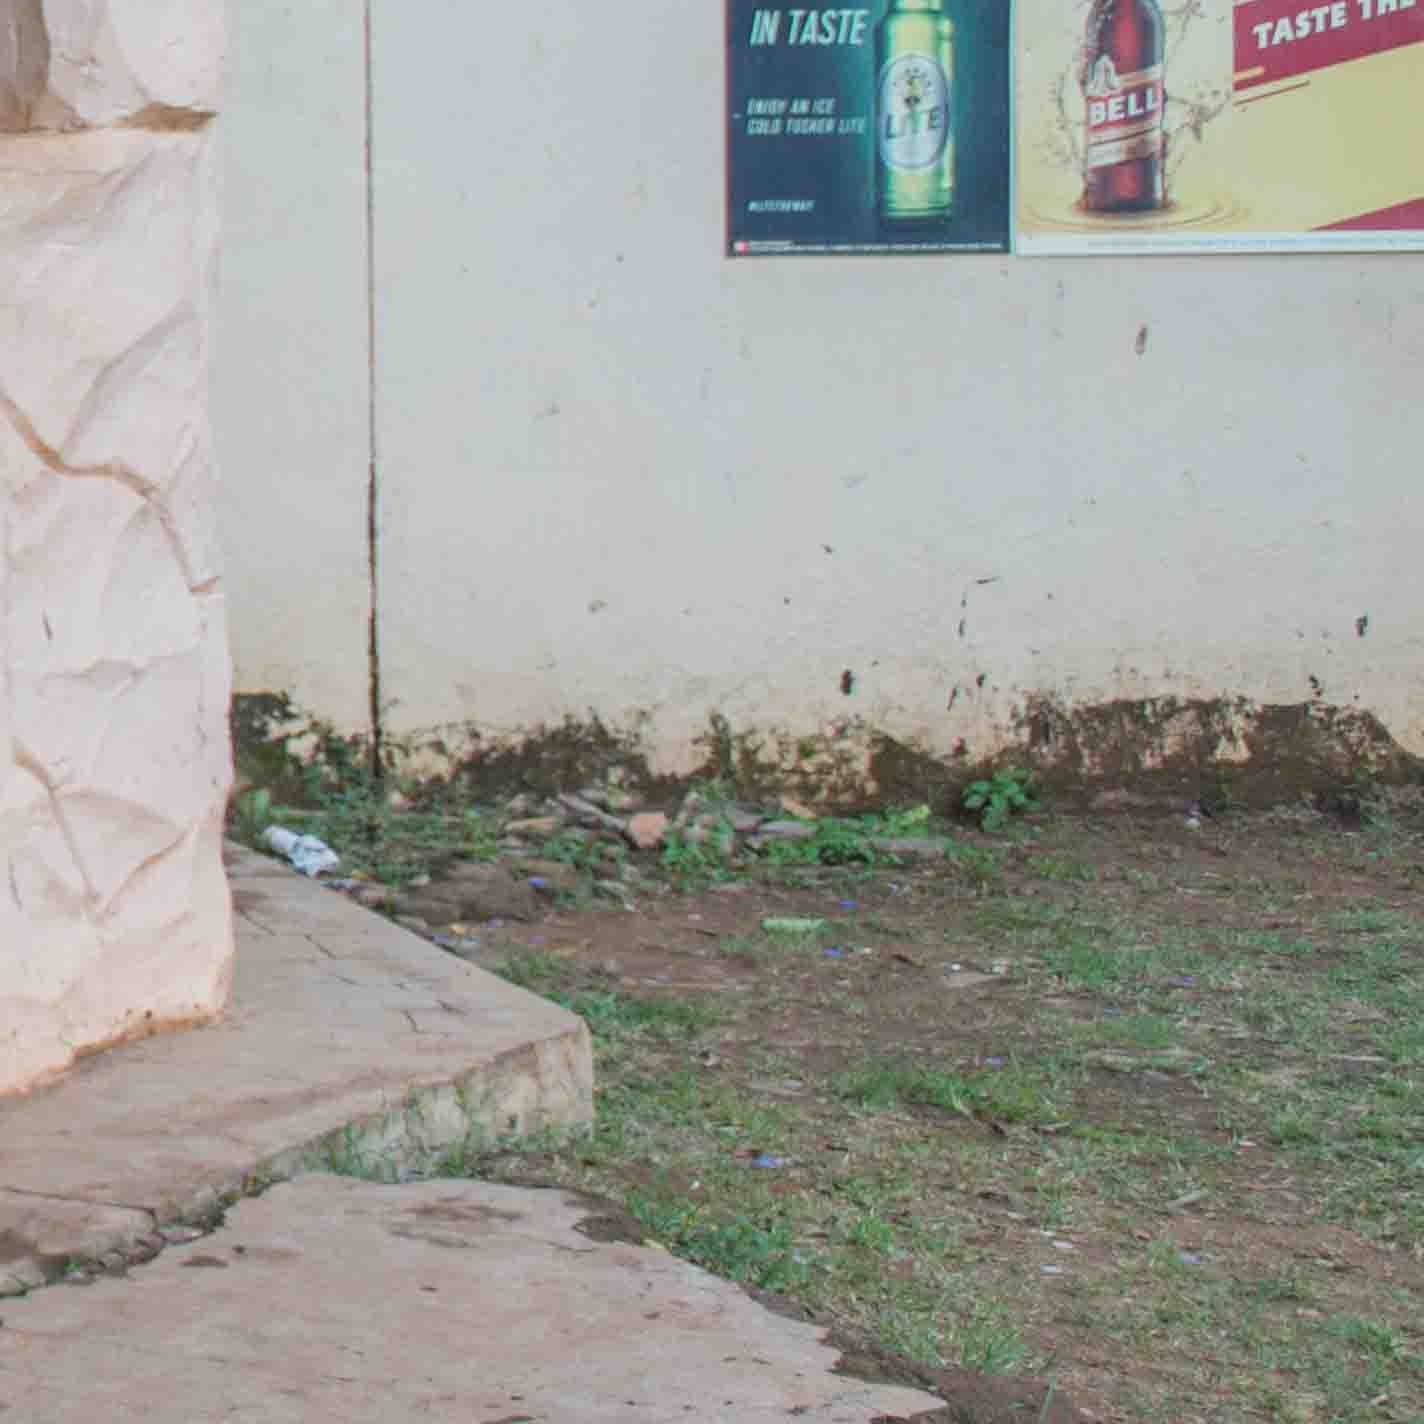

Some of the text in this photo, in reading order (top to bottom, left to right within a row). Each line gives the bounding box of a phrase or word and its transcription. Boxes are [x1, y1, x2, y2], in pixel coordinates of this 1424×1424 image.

[750, 8, 871, 47] IN TASTE
[1251, 0, 1348, 49] TASTE
[1088, 87, 1163, 124] BELL
